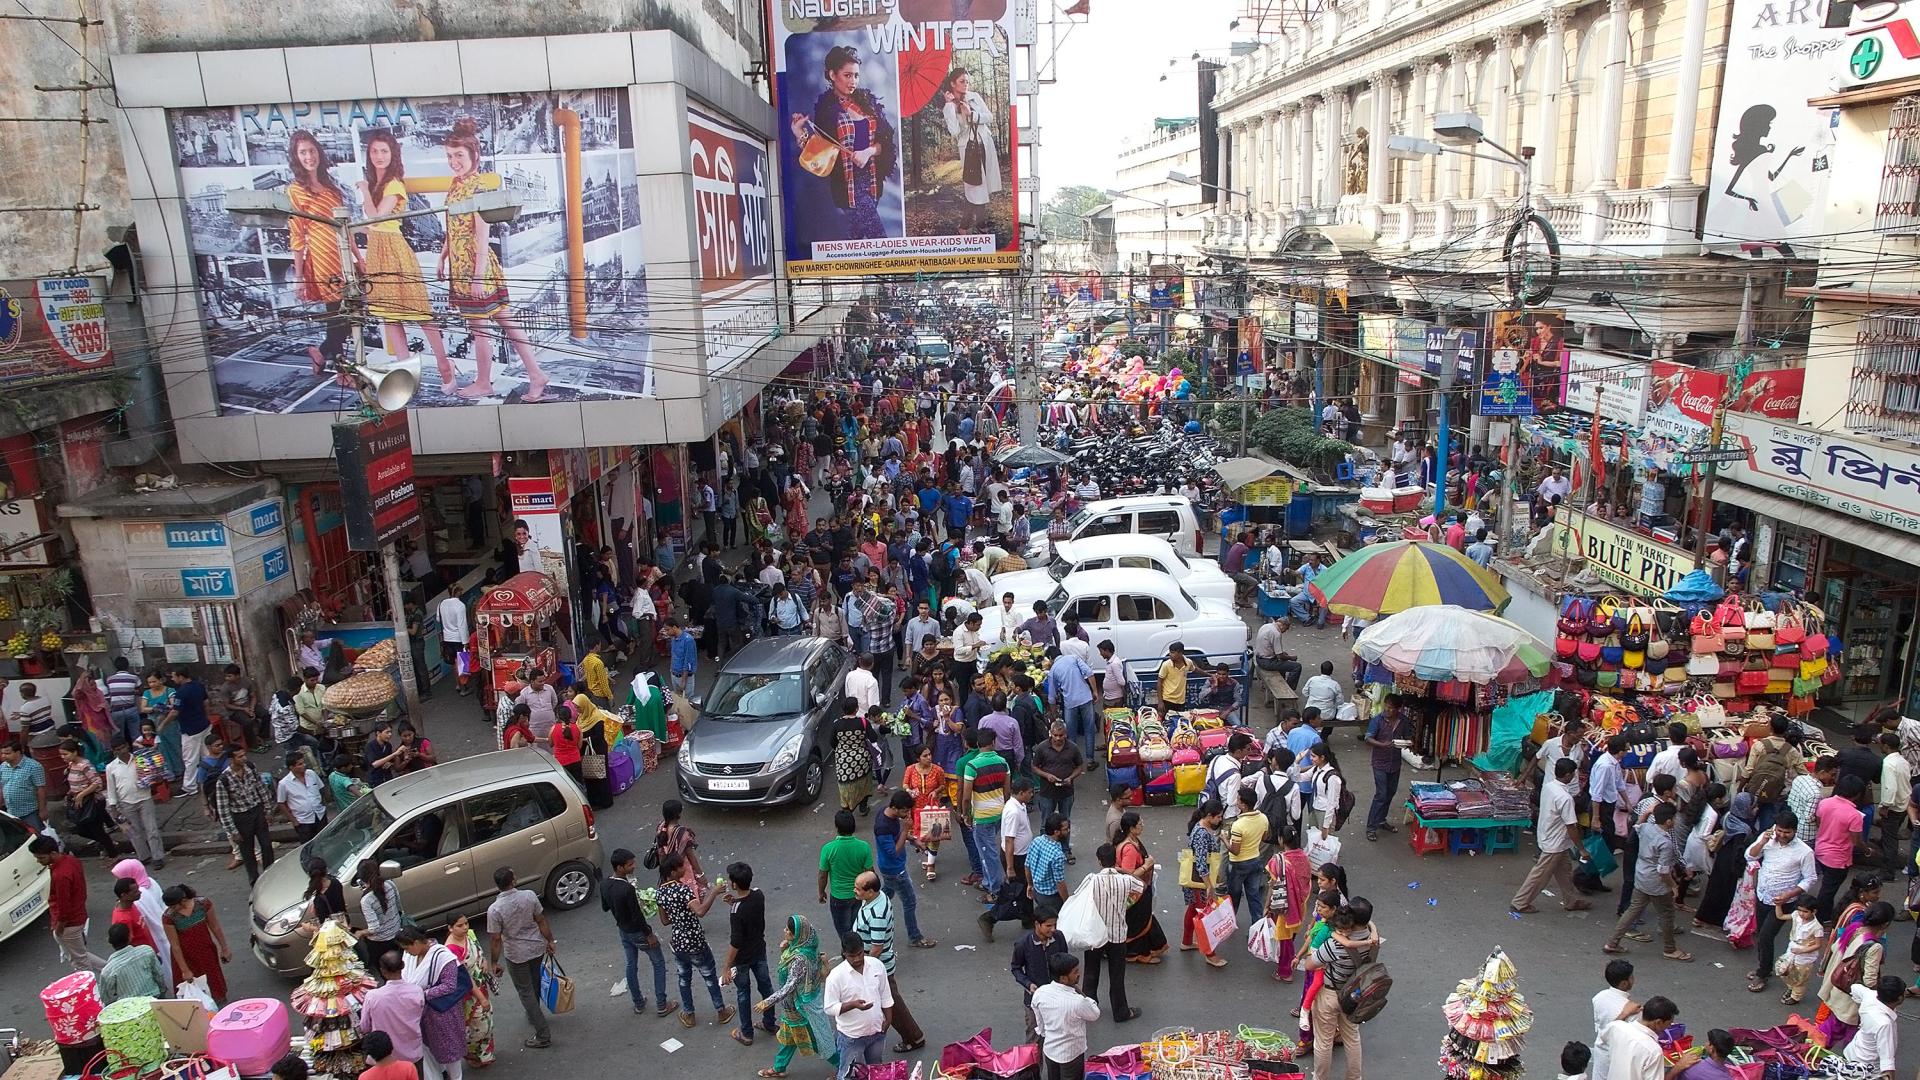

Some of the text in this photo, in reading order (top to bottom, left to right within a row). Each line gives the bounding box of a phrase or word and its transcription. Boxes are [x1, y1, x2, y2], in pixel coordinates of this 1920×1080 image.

[1751, 0, 1822, 29] AR
[1749, 36, 1845, 60] The Shopper
[239, 98, 418, 131] RAPHAAA
[690, 138, 737, 279] সিটি
[817, 236, 991, 252] MENS WEAR-LADIES WEAR-KIDS WEAR
[790, 265, 805, 273] NEW
[806, 263, 832, 272] MARKET
[835, 260, 882, 271] CHOWRINGHEE
[885, 258, 917, 268] GARIAHAT
[920, 257, 956, 267] HATIBAGAN
[959, 257, 976, 266] LAKE
[977, 255, 994, 264] MALL
[43, 280, 62, 291] BUY
[60, 306, 80, 322] GIFT
[1646, 415, 1673, 432] PANDIT
[1674, 422, 1689, 437] PAN
[1772, 426, 1791, 439] নিউ
[377, 463, 400, 481] Available
[374, 492, 391, 510] planet
[390, 481, 414, 500] Fashion
[515, 495, 553, 505] citi mart
[253, 509, 281, 530] mart
[131, 524, 221, 545] citi mart
[1587, 535, 1633, 575] BLUE
[1614, 534, 1676, 567] NEW MARKET
[264, 551, 285, 574] মার্ট
[185, 570, 227, 595] মার্ট
[1590, 563, 1630, 591] CHEMISTS
[1633, 584, 1640, 593] &
